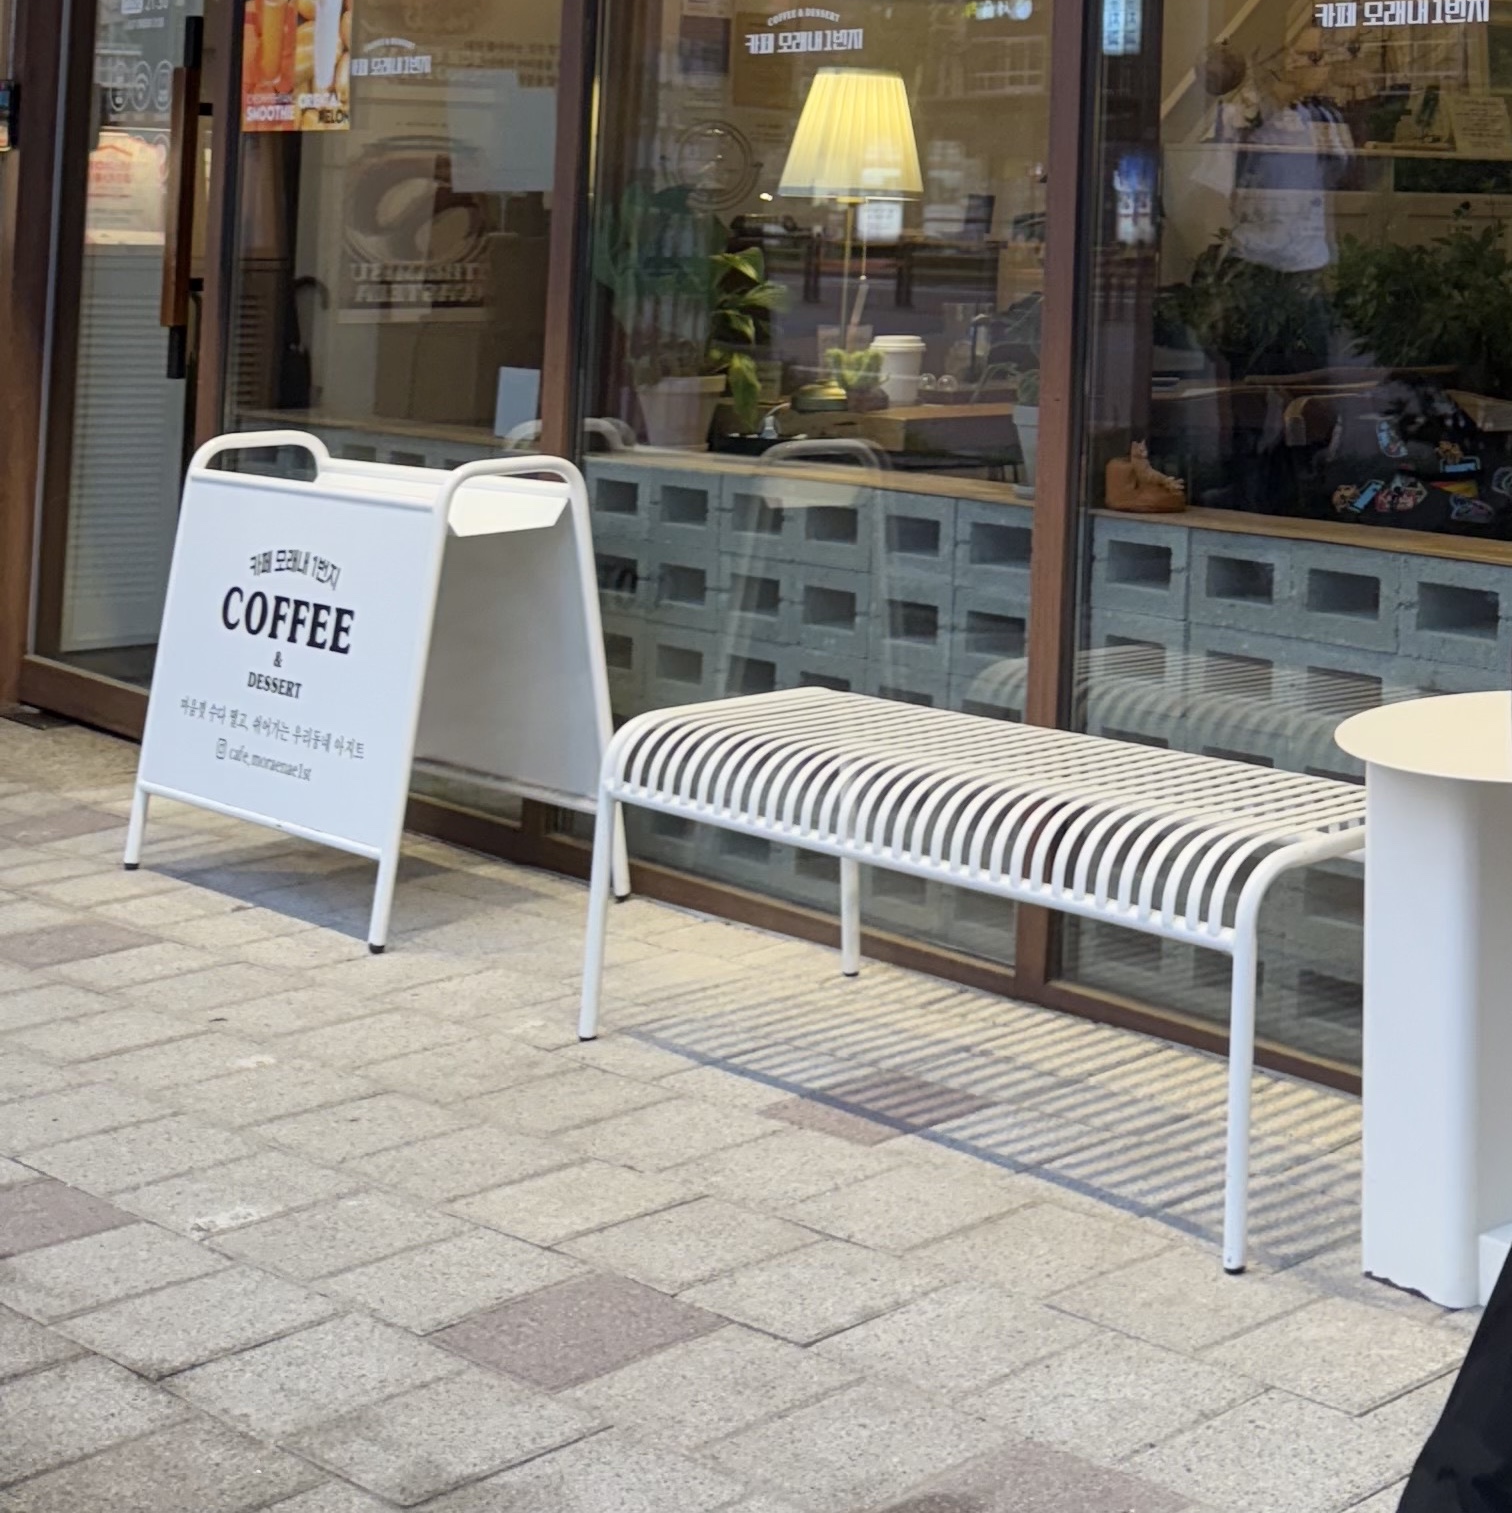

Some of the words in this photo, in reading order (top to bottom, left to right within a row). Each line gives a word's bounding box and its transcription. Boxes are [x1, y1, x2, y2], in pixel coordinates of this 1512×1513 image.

[1314, 2, 1357, 28] 카페
[745, 33, 774, 54] 카페
[250, 550, 272, 576] 카페
[222, 586, 355, 654] COFFEE
[273, 651, 283, 668] &
[247, 671, 303, 699] DESSERT
